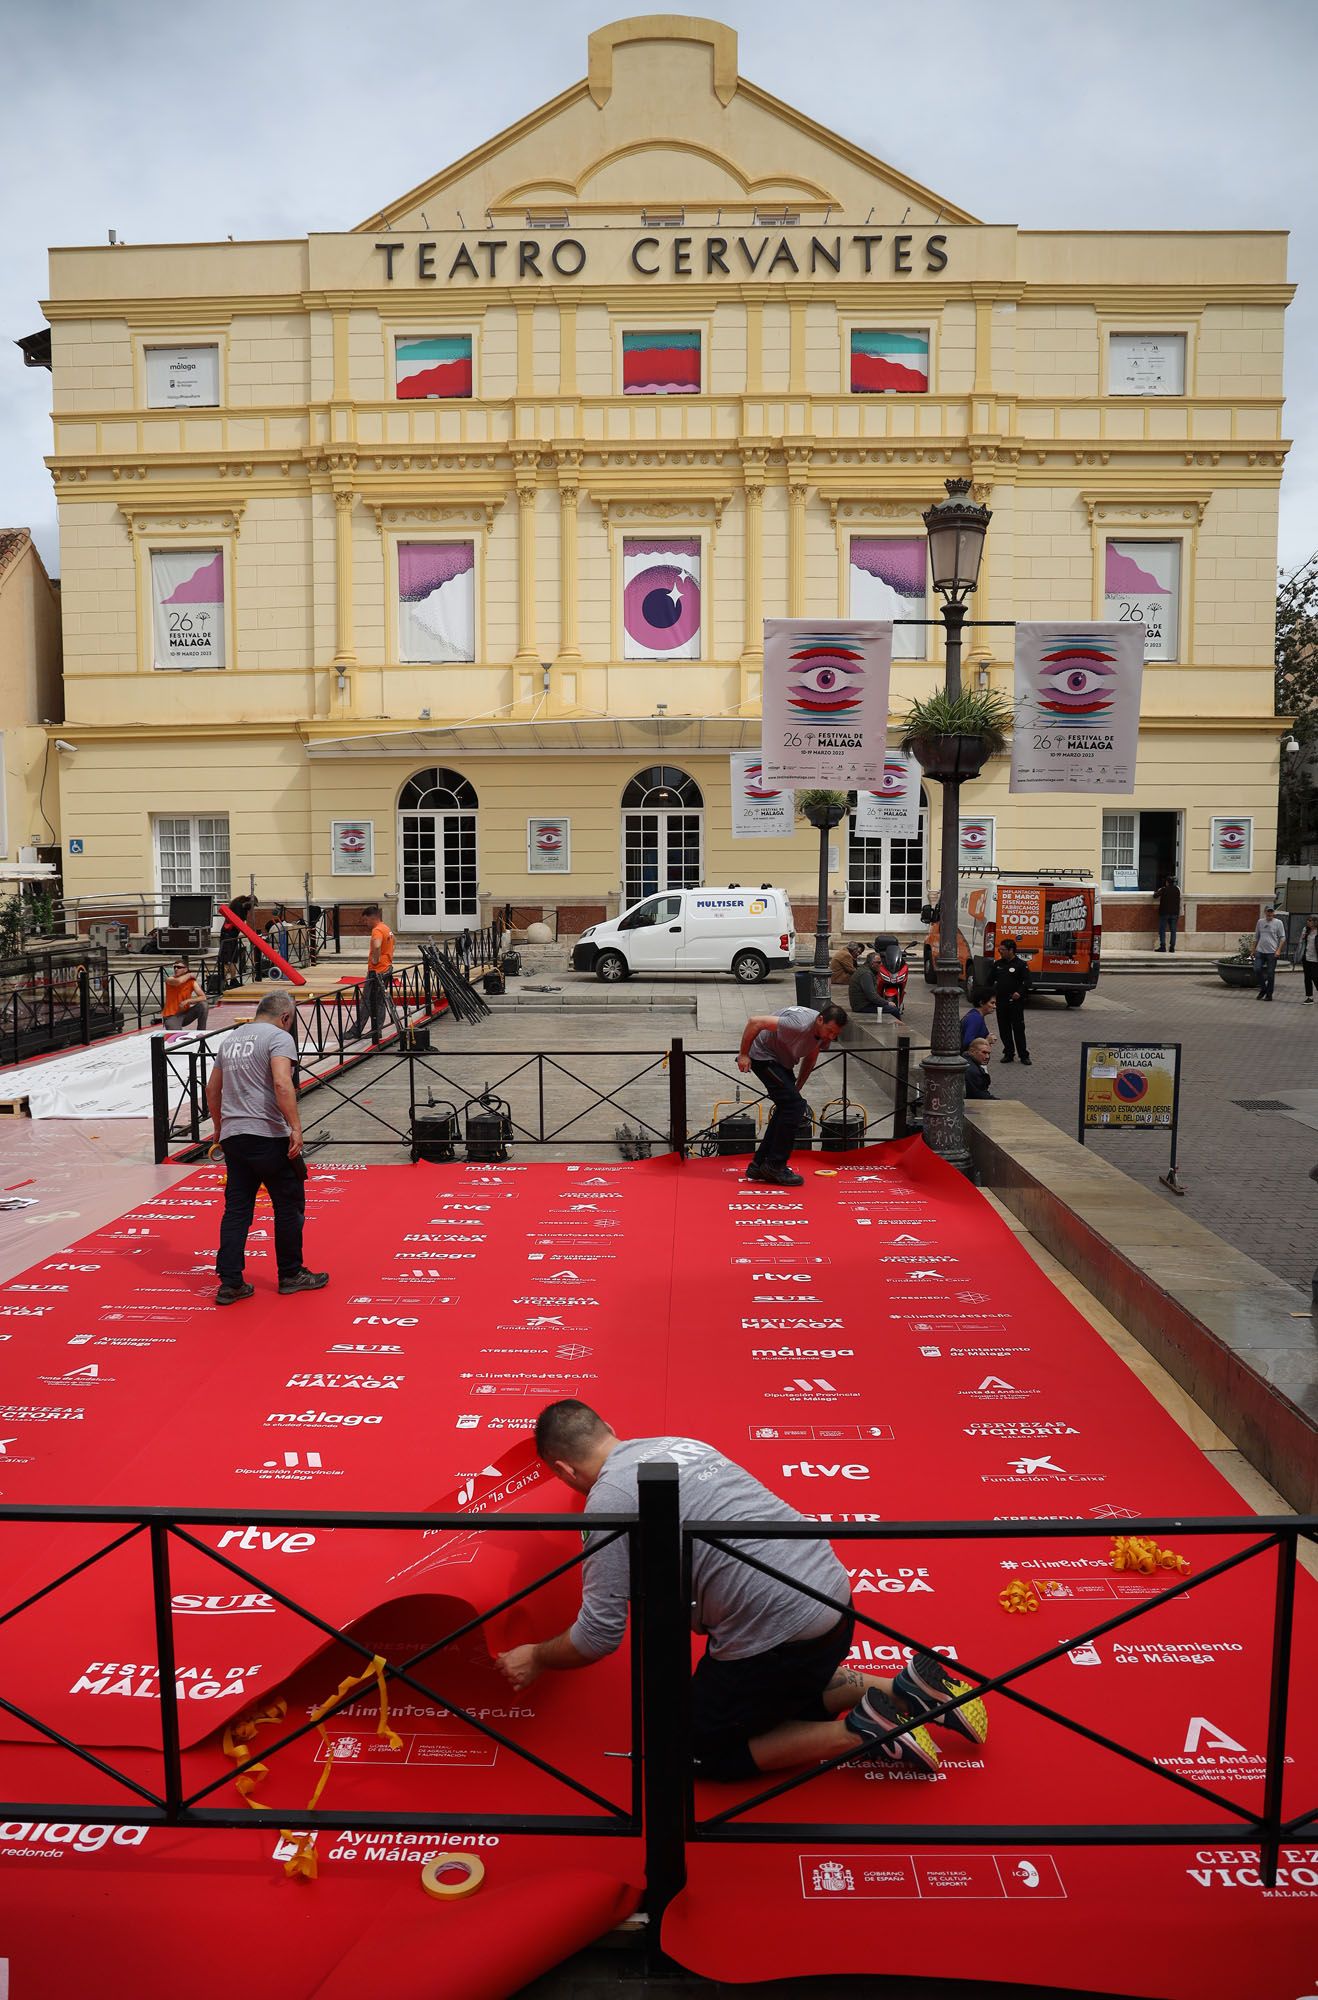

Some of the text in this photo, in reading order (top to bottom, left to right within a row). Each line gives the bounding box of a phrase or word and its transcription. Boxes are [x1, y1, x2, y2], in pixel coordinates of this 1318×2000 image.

[375, 234, 948, 280] TEATRO CERVANTES
[1119, 602, 1143, 621] 26
[169, 612, 193, 631] 26
[783, 732, 802, 748] 26
[818, 732, 852, 740] FESTIVAL
[1033, 734, 1052, 750] 26
[743, 808, 754, 817] 26
[866, 807, 877, 816] 26
[696, 900, 745, 908] MULTISER
[1051, 894, 1085, 913] PRODUCIMOS
[1001, 914, 1040, 925] TODO
[222, 1041, 255, 1059] MRD
[1140, 1052, 1166, 1060] LOCAL
[1120, 1060, 1153, 1068] MALAGA
[1087, 1104, 1172, 1114] PROHIBIDO ESTACIONAR DESDE
[1086, 1113, 1098, 1121] LAS
[1122, 1113, 1134, 1121] DEL
[1135, 1113, 1145, 1122] DIA
[442, 1203, 492, 1211] rtve
[394, 1251, 477, 1259] málaga
[42, 1262, 102, 1272] rtve
[752, 1272, 812, 1282] rtve
[352, 1315, 420, 1327] rtve
[331, 1343, 402, 1352] SUR
[751, 1346, 855, 1359] málaga
[291, 1373, 375, 1381] FESTIVAL
[266, 1409, 384, 1426] málaga
[962, 1427, 1081, 1436] VICTORIA
[235, 1468, 344, 1476] Diputación Provincial
[781, 1461, 871, 1481] rtve
[980, 1475, 1049, 1483] Fundación
[216, 1525, 317, 1554] rtve
[898, 1567, 930, 1577] DE
[171, 1593, 274, 1609] SUR
[1112, 1642, 1244, 1654] Ayuntamiento
[1115, 1652, 1215, 1666] de Málaga
[225, 1664, 263, 1679] DE
[1153, 1755, 1217, 1765] Junta de
[864, 1769, 948, 1783] de Málaga
[1175, 1768, 1225, 1776] Consejería
[1191, 1774, 1227, 1782] Cultura
[336, 1829, 501, 1848] Ayuntamiento
[1, 1847, 64, 1858] redonda
[328, 1846, 357, 1861] de
